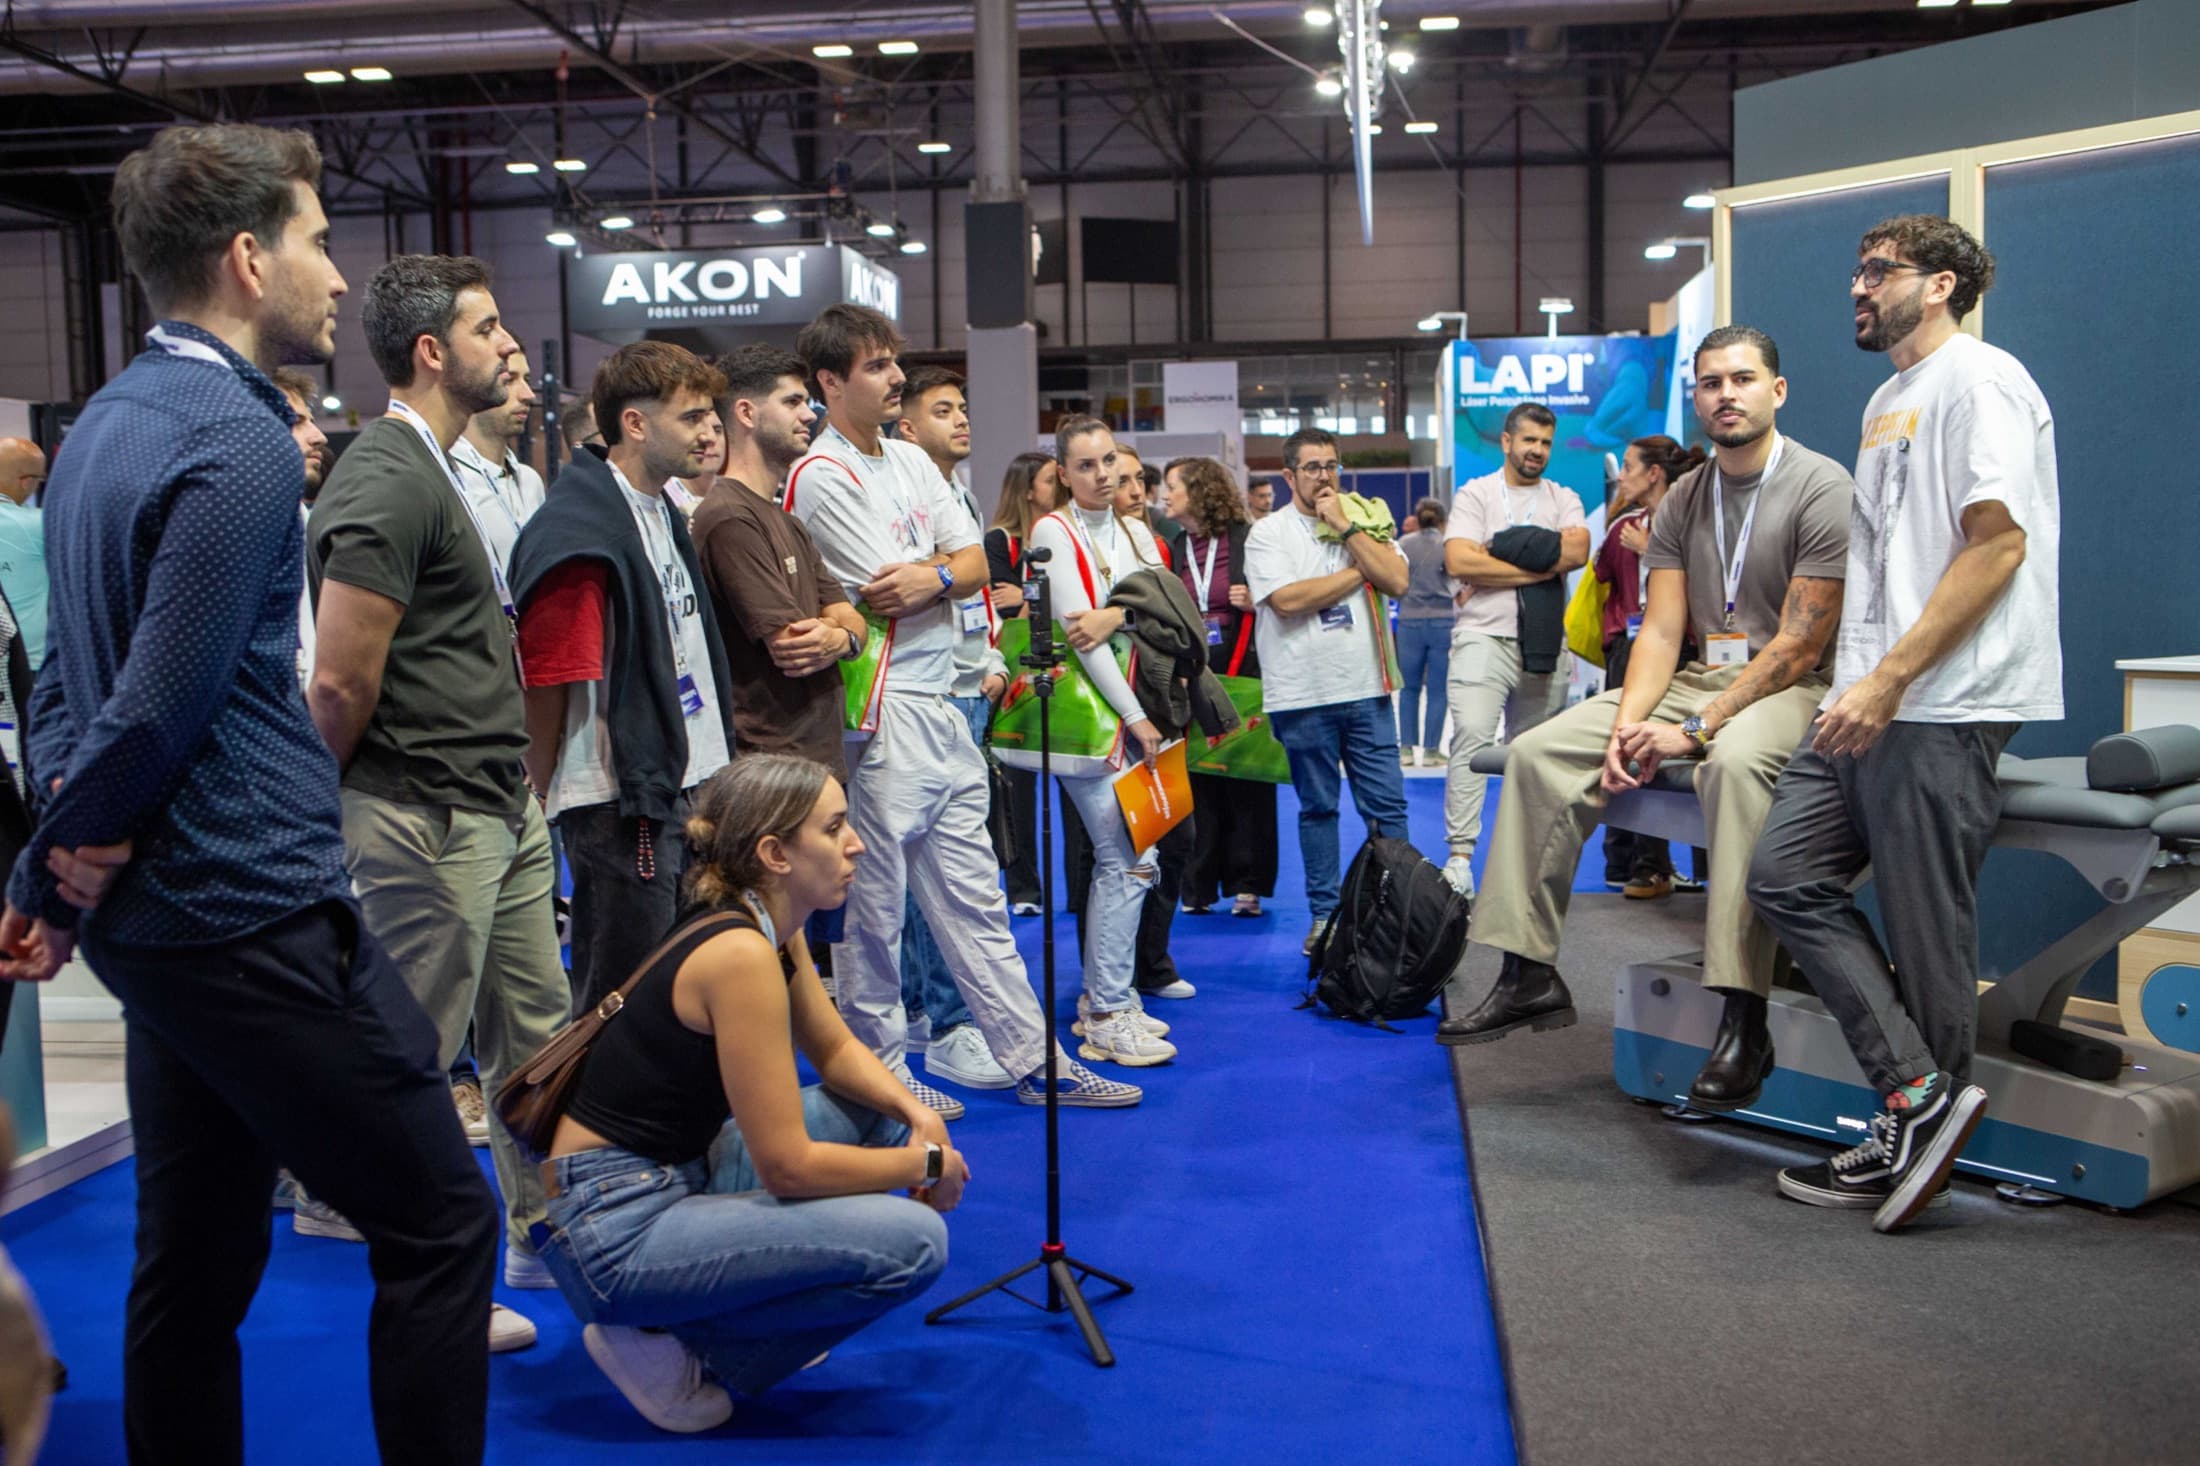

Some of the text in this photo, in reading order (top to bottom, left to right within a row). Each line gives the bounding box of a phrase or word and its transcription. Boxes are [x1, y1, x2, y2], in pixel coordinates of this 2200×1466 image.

[602, 255, 804, 306] AKON
[850, 262, 897, 320] AKON
[647, 303, 760, 319] FORGE YOUR BEST
[1459, 353, 1584, 394] LAPI
